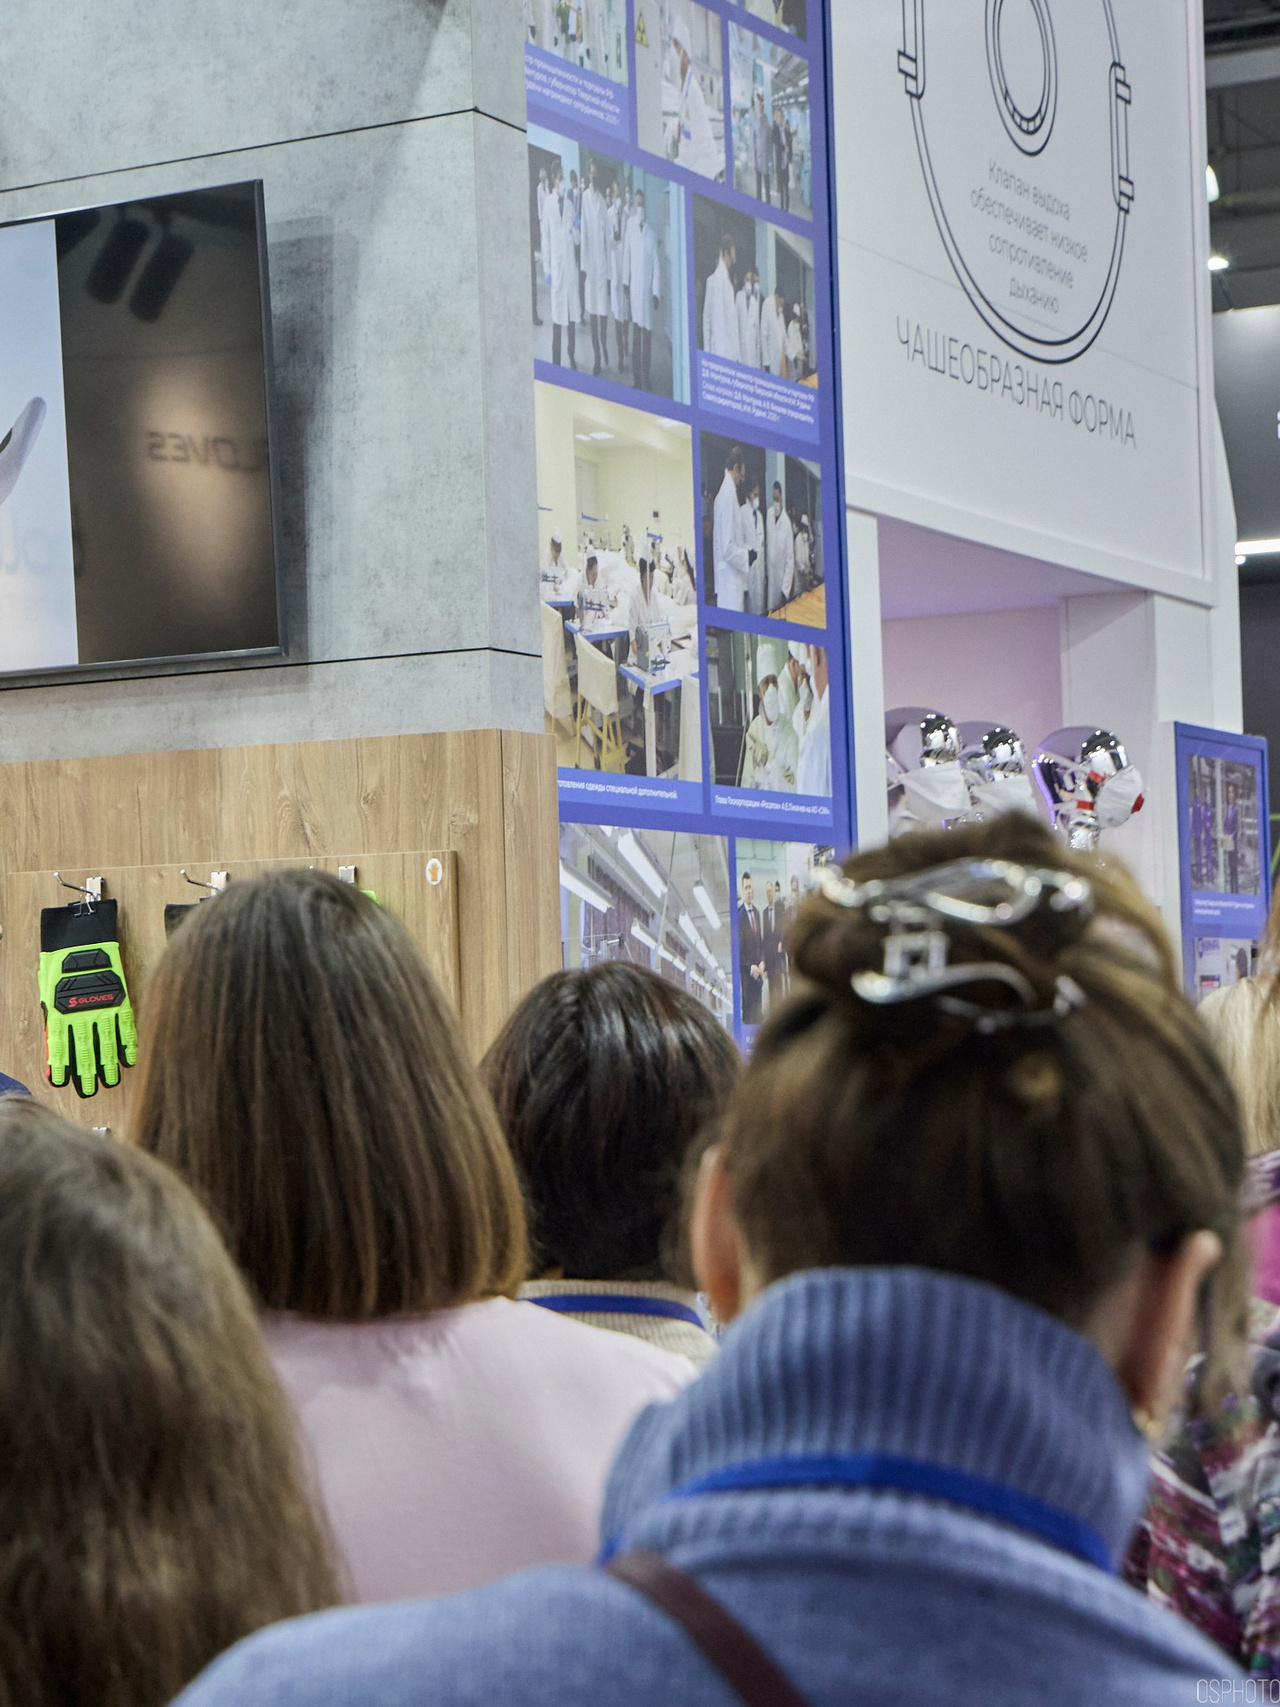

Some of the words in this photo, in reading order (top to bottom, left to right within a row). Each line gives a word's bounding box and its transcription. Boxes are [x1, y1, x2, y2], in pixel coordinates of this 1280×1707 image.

[988, 158, 1030, 196] Клапан
[1032, 186, 1070, 221] выдоха
[970, 187, 1049, 242] обеспечивает
[1050, 229, 1088, 263] низкое
[988, 233, 1074, 289] сопротивление
[1009, 276, 1059, 314] дыханию
[896, 315, 1064, 422] ЧАШЕОБРАЗНАЯ
[1069, 390, 1137, 449] ФОРМА
